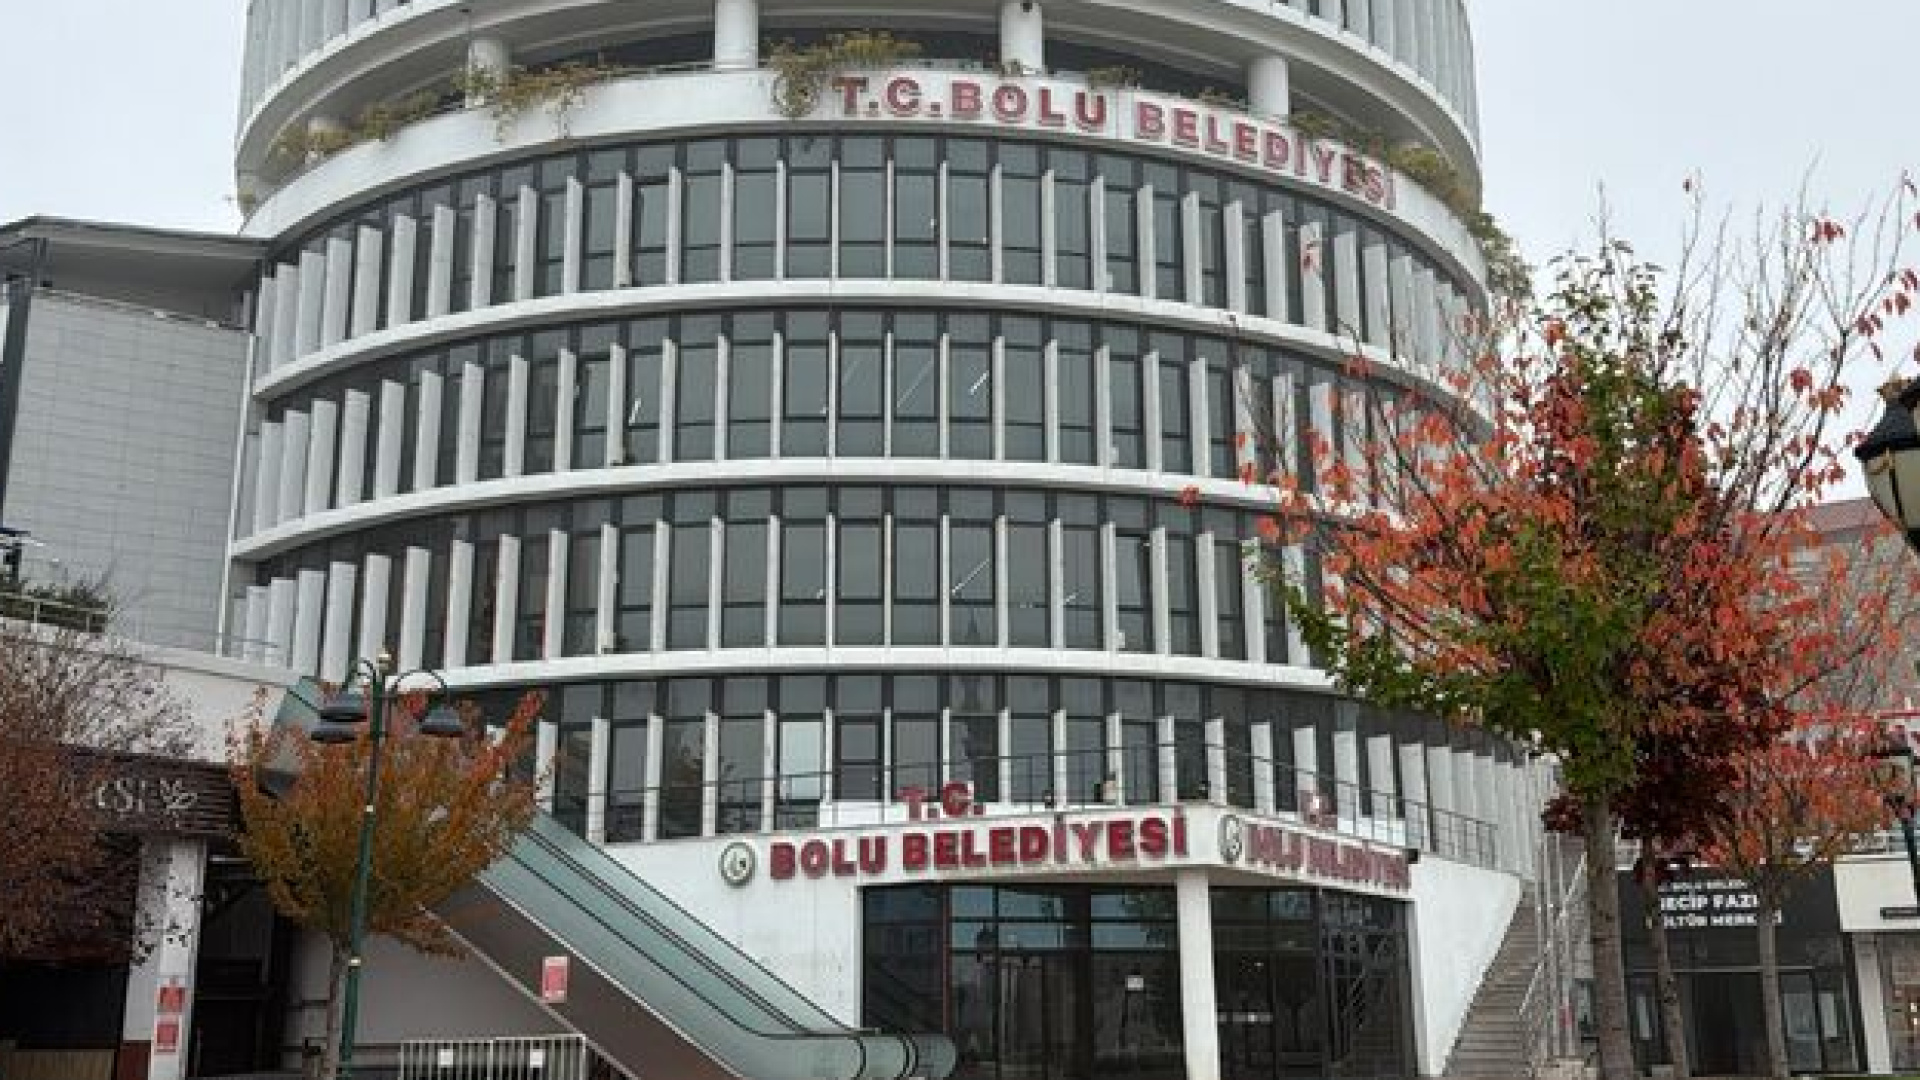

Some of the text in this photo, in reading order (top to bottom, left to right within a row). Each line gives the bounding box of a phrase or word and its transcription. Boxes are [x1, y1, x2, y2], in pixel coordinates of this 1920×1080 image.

[896, 781, 985, 819] T.C.
[770, 806, 1189, 880] BOLU BELEDİYESİ
